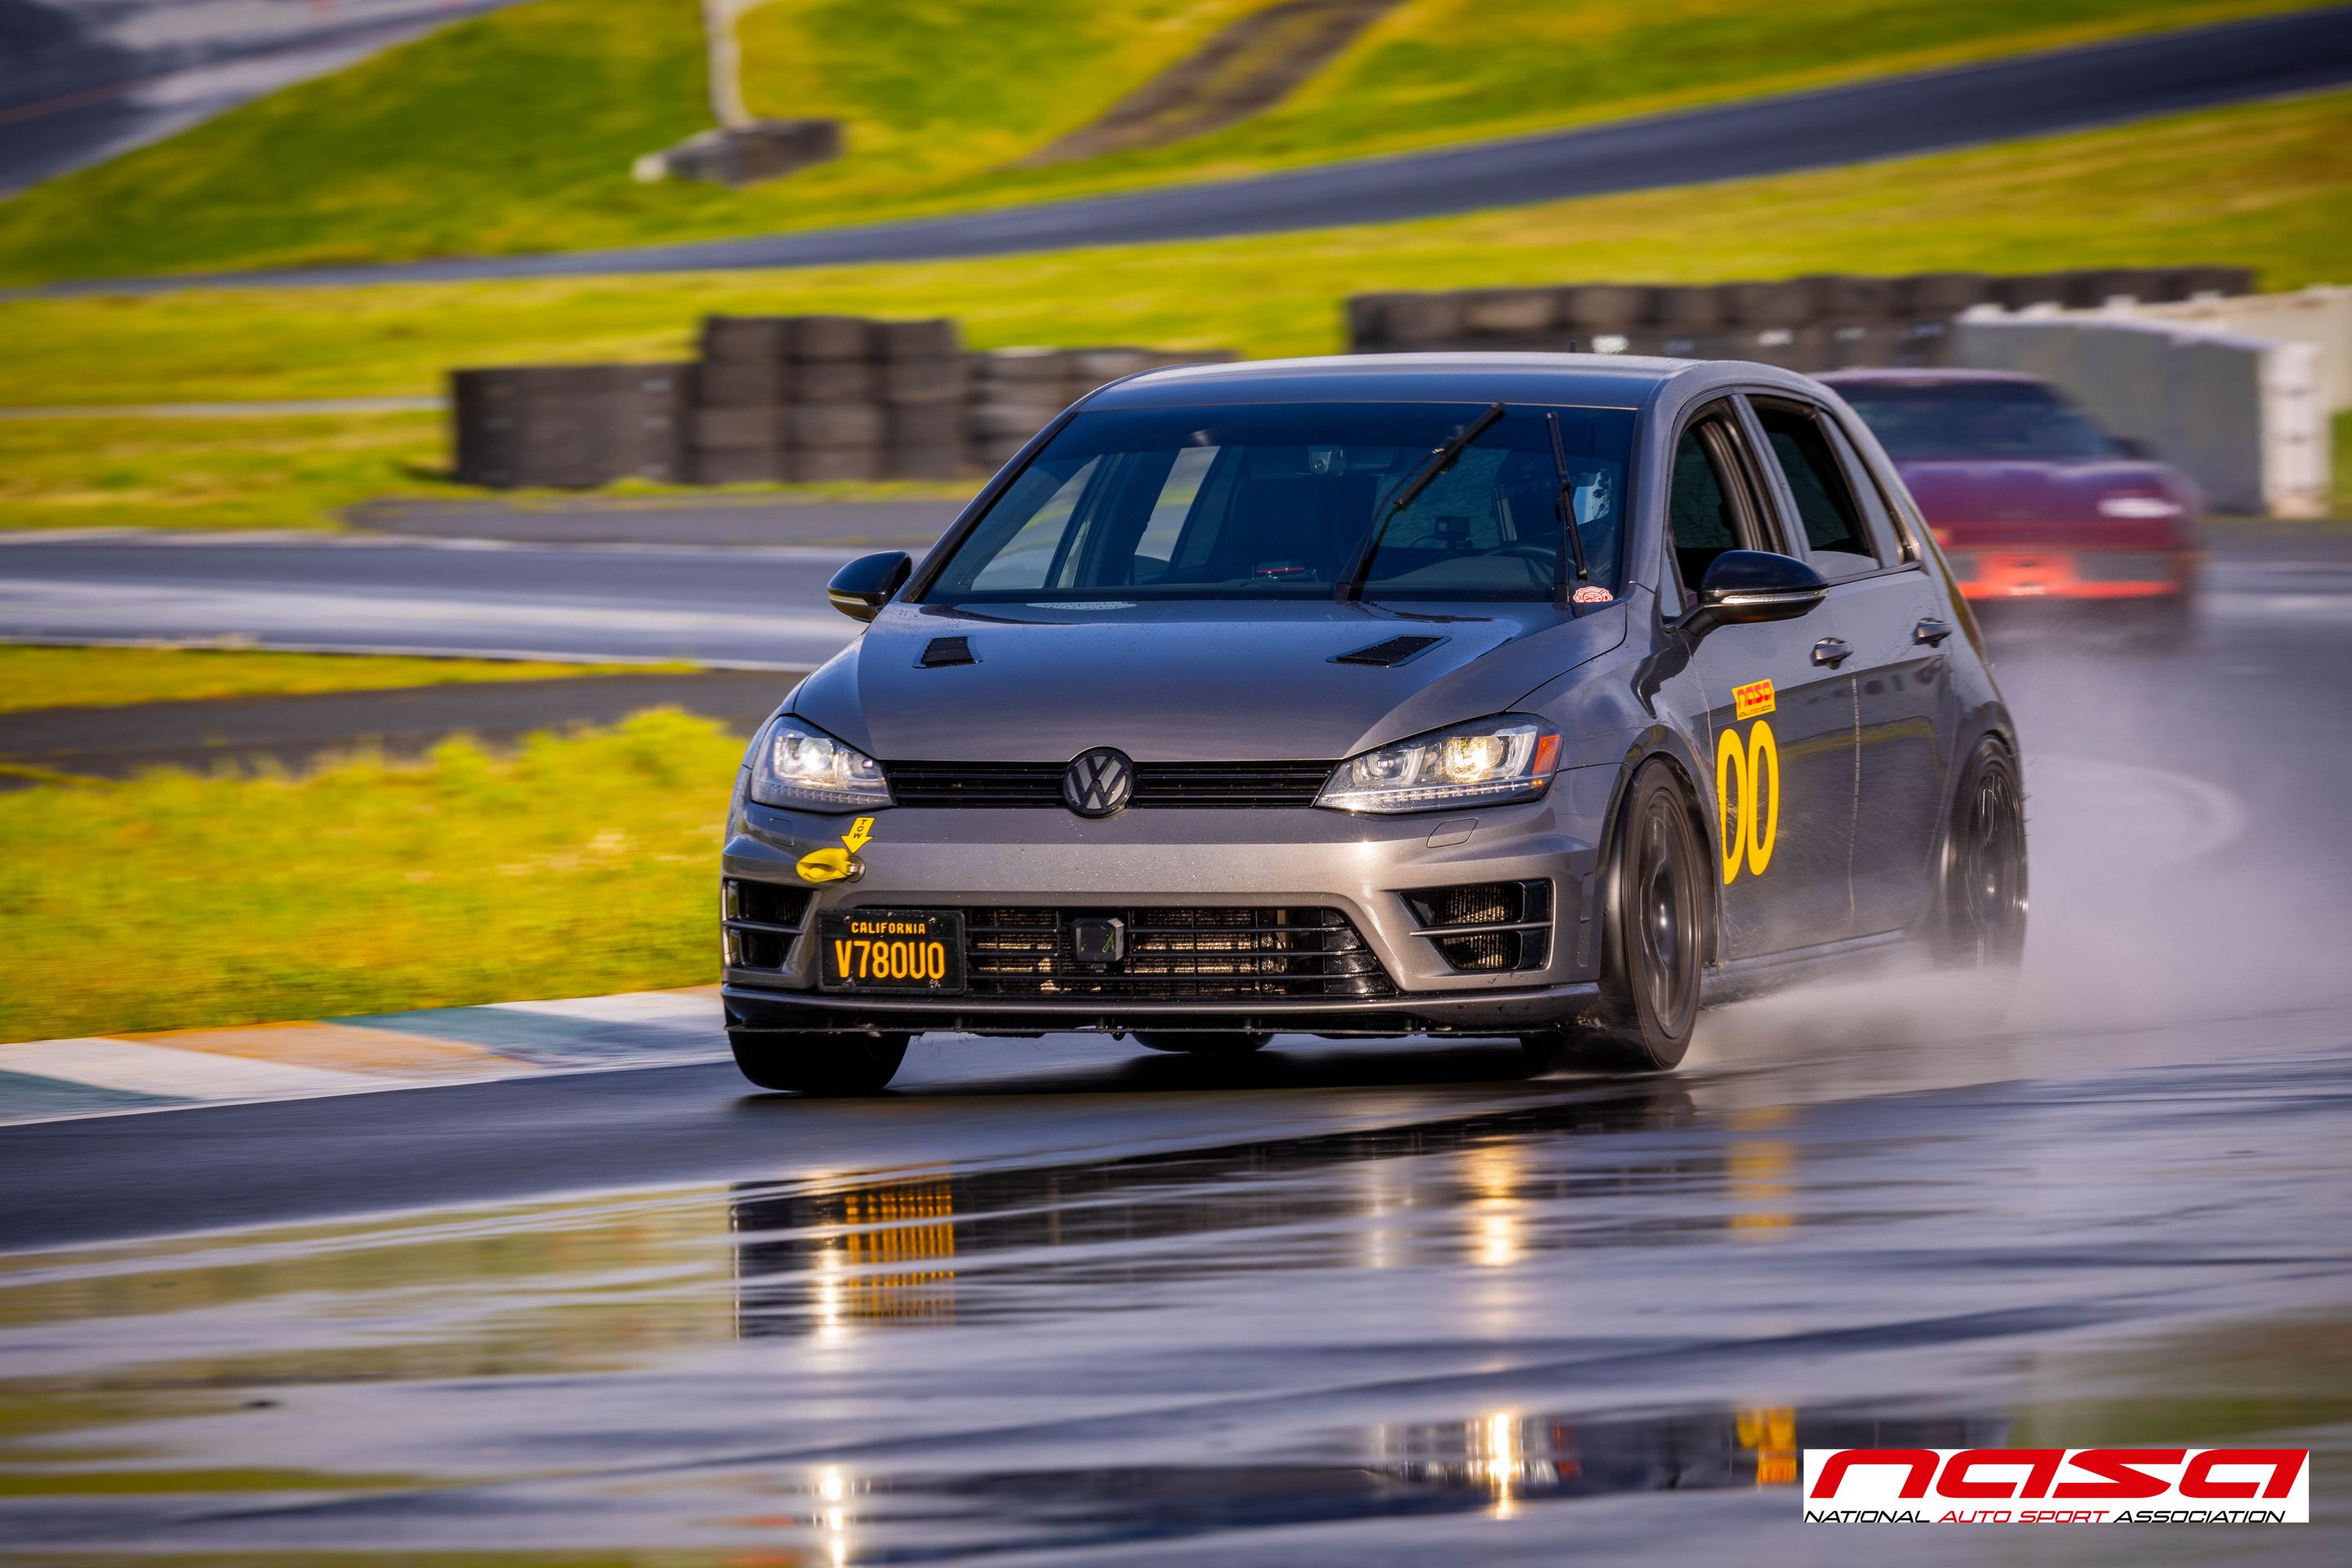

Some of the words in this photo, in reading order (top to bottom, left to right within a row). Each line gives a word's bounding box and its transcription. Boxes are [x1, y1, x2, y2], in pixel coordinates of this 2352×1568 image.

[1717, 719, 1779, 885] 00
[853, 819, 868, 840] TOW
[851, 921, 926, 934] CALIFORNIA
